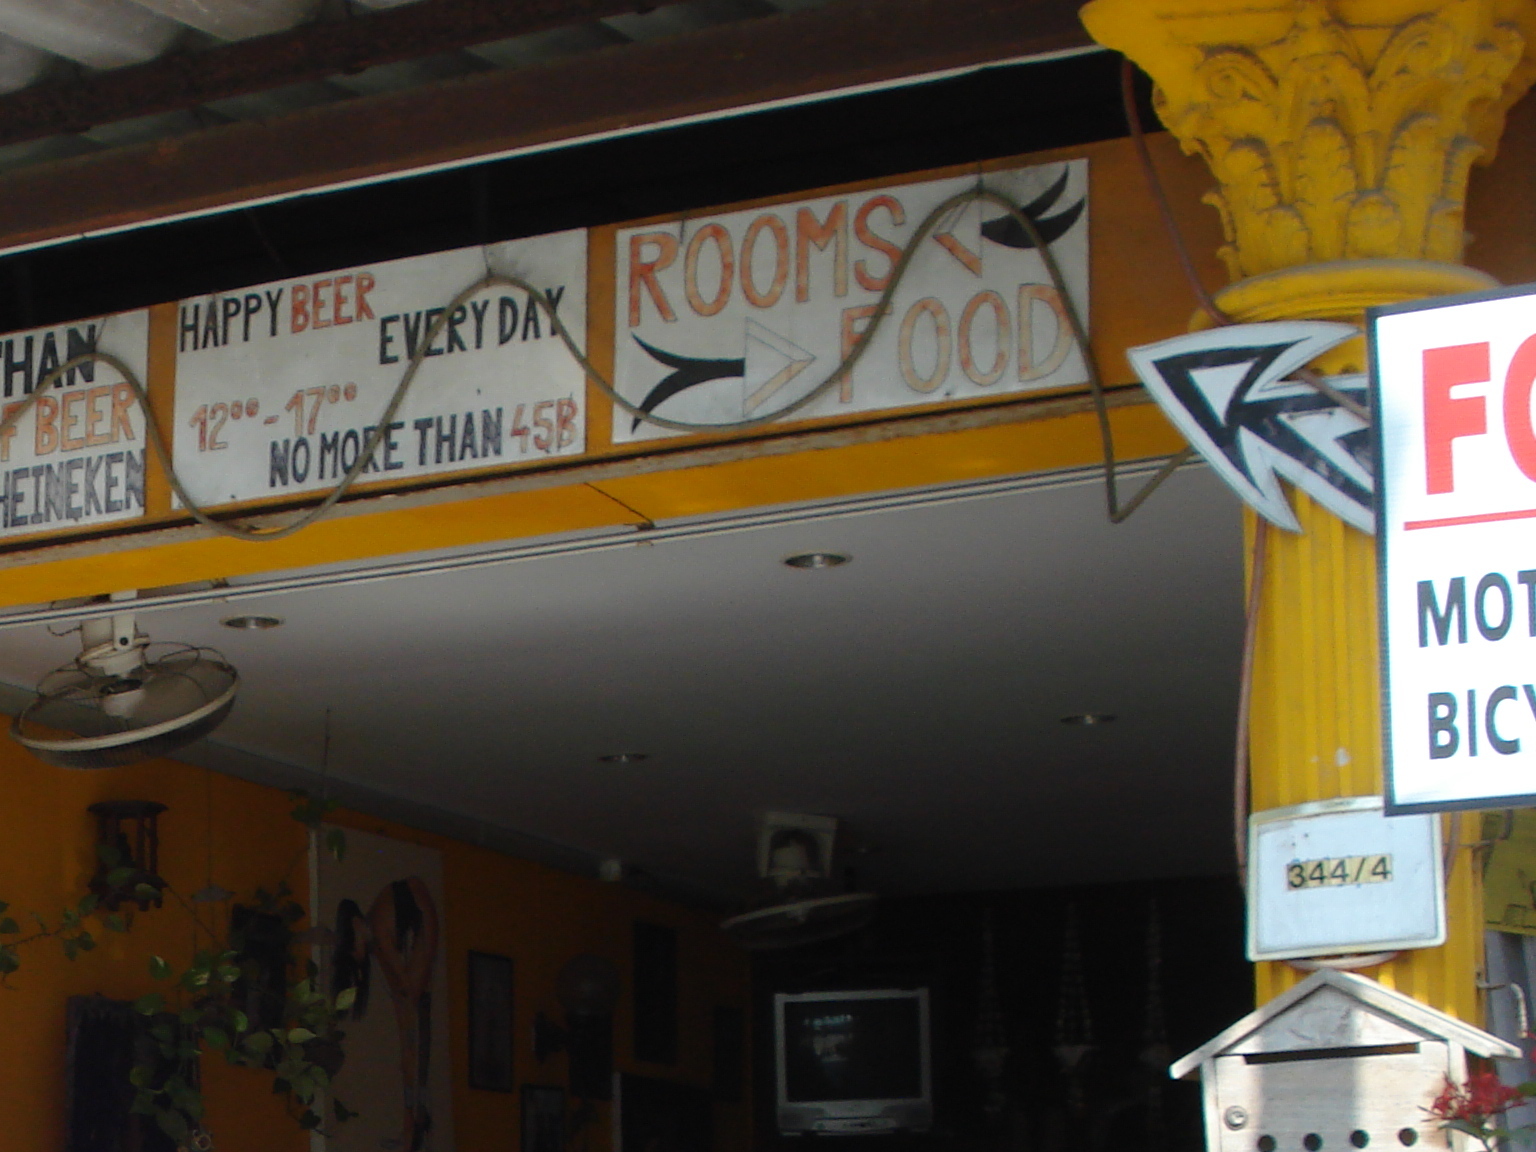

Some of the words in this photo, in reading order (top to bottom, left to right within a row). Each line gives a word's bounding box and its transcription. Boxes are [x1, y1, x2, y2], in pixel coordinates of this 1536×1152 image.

[629, 195, 905, 327] ROOMS
[180, 288, 283, 352] HAPPY
[290, 272, 375, 333] BEER
[839, 284, 1073, 403] FOOD
[35, 382, 137, 456] BEER
[269, 436, 310, 487] NO
[319, 422, 405, 480] MORE
[414, 407, 503, 467] THAN
[1289, 856, 1392, 888] 344/4
